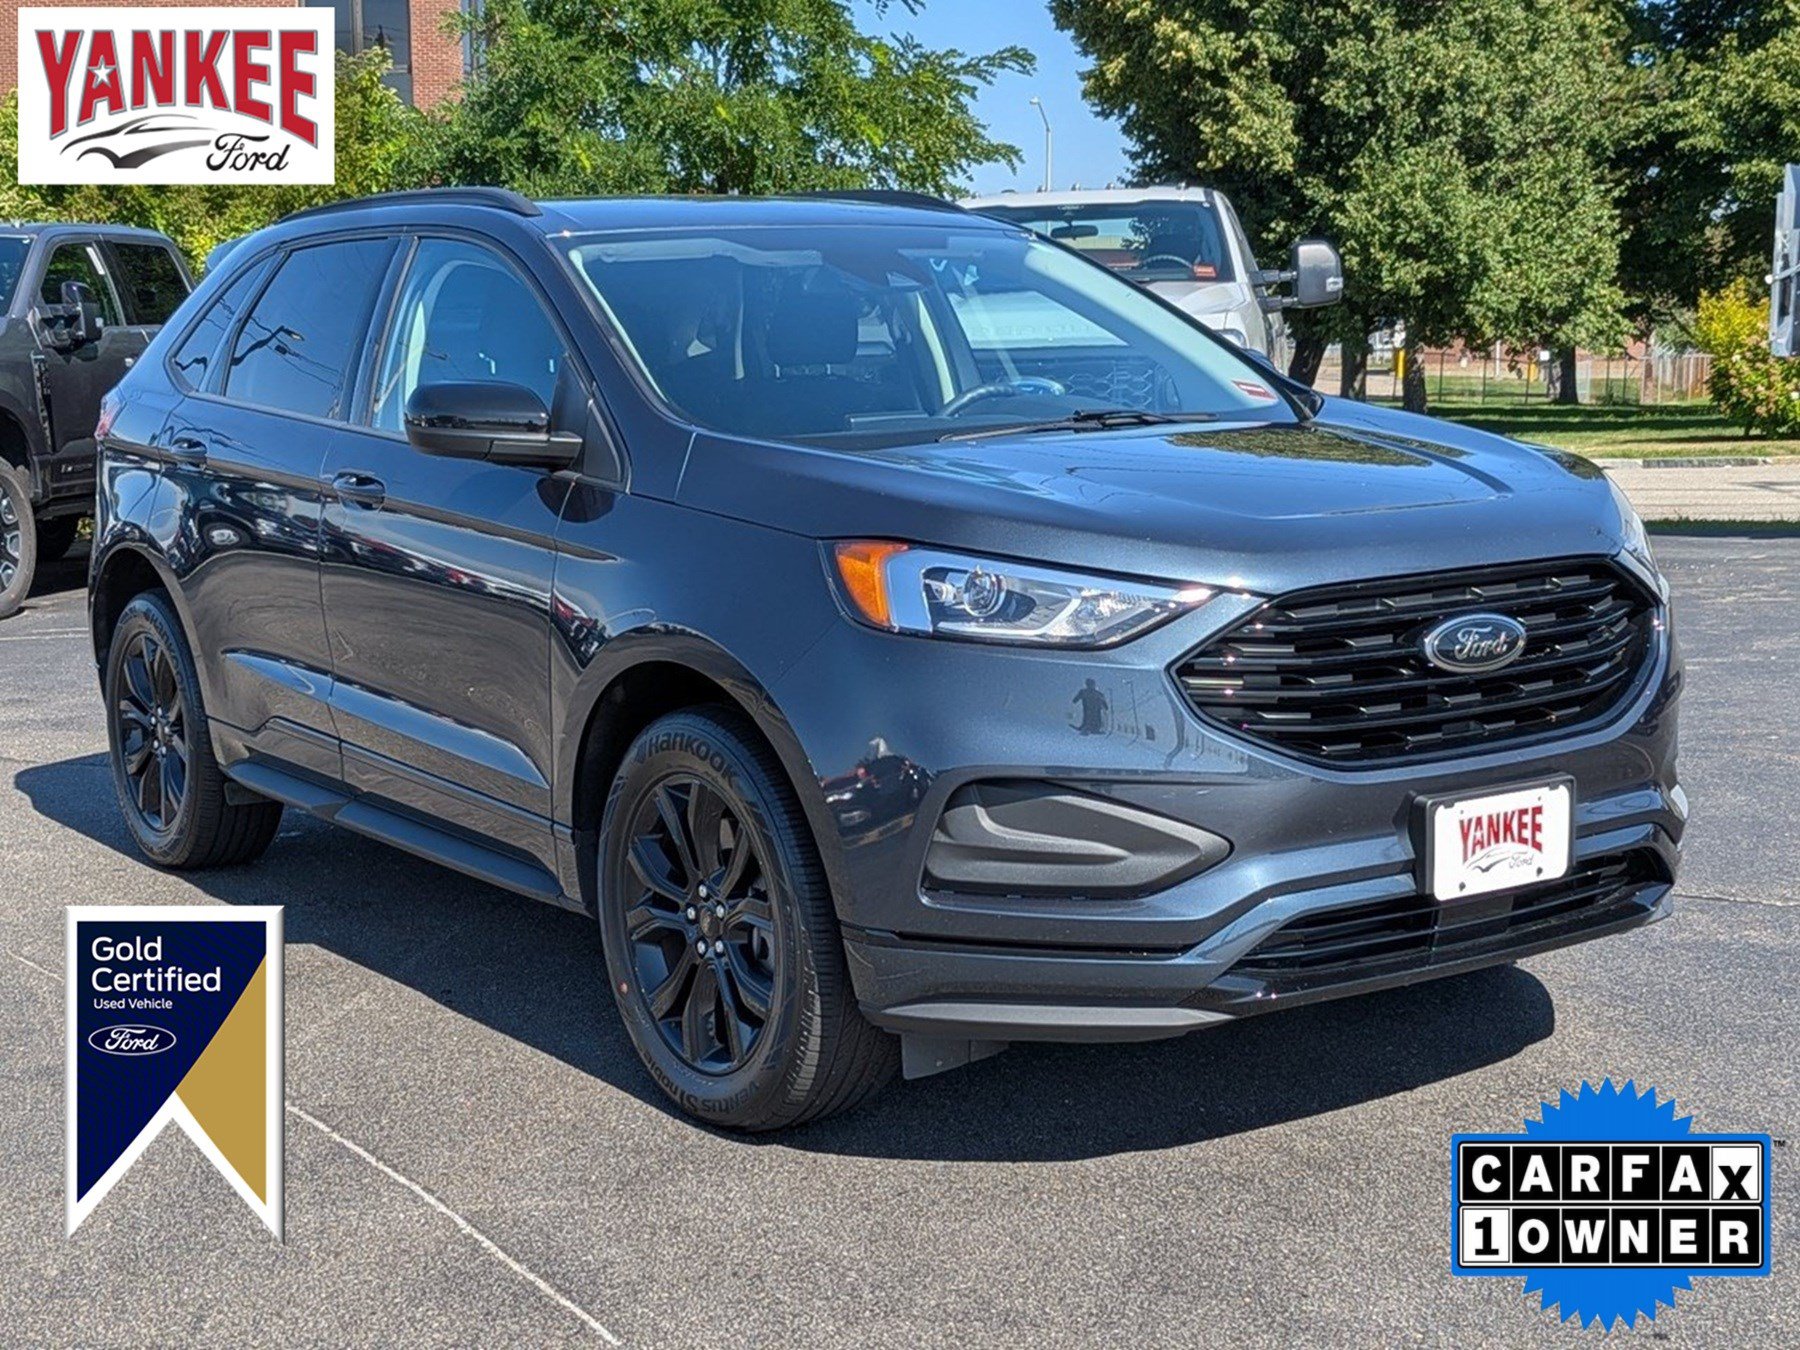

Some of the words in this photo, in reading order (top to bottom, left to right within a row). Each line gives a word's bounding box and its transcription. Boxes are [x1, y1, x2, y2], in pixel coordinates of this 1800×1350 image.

[1454, 626, 1508, 661] Ford
[1458, 805, 1543, 866] YANKEE
[1509, 853, 1535, 869] Ford
